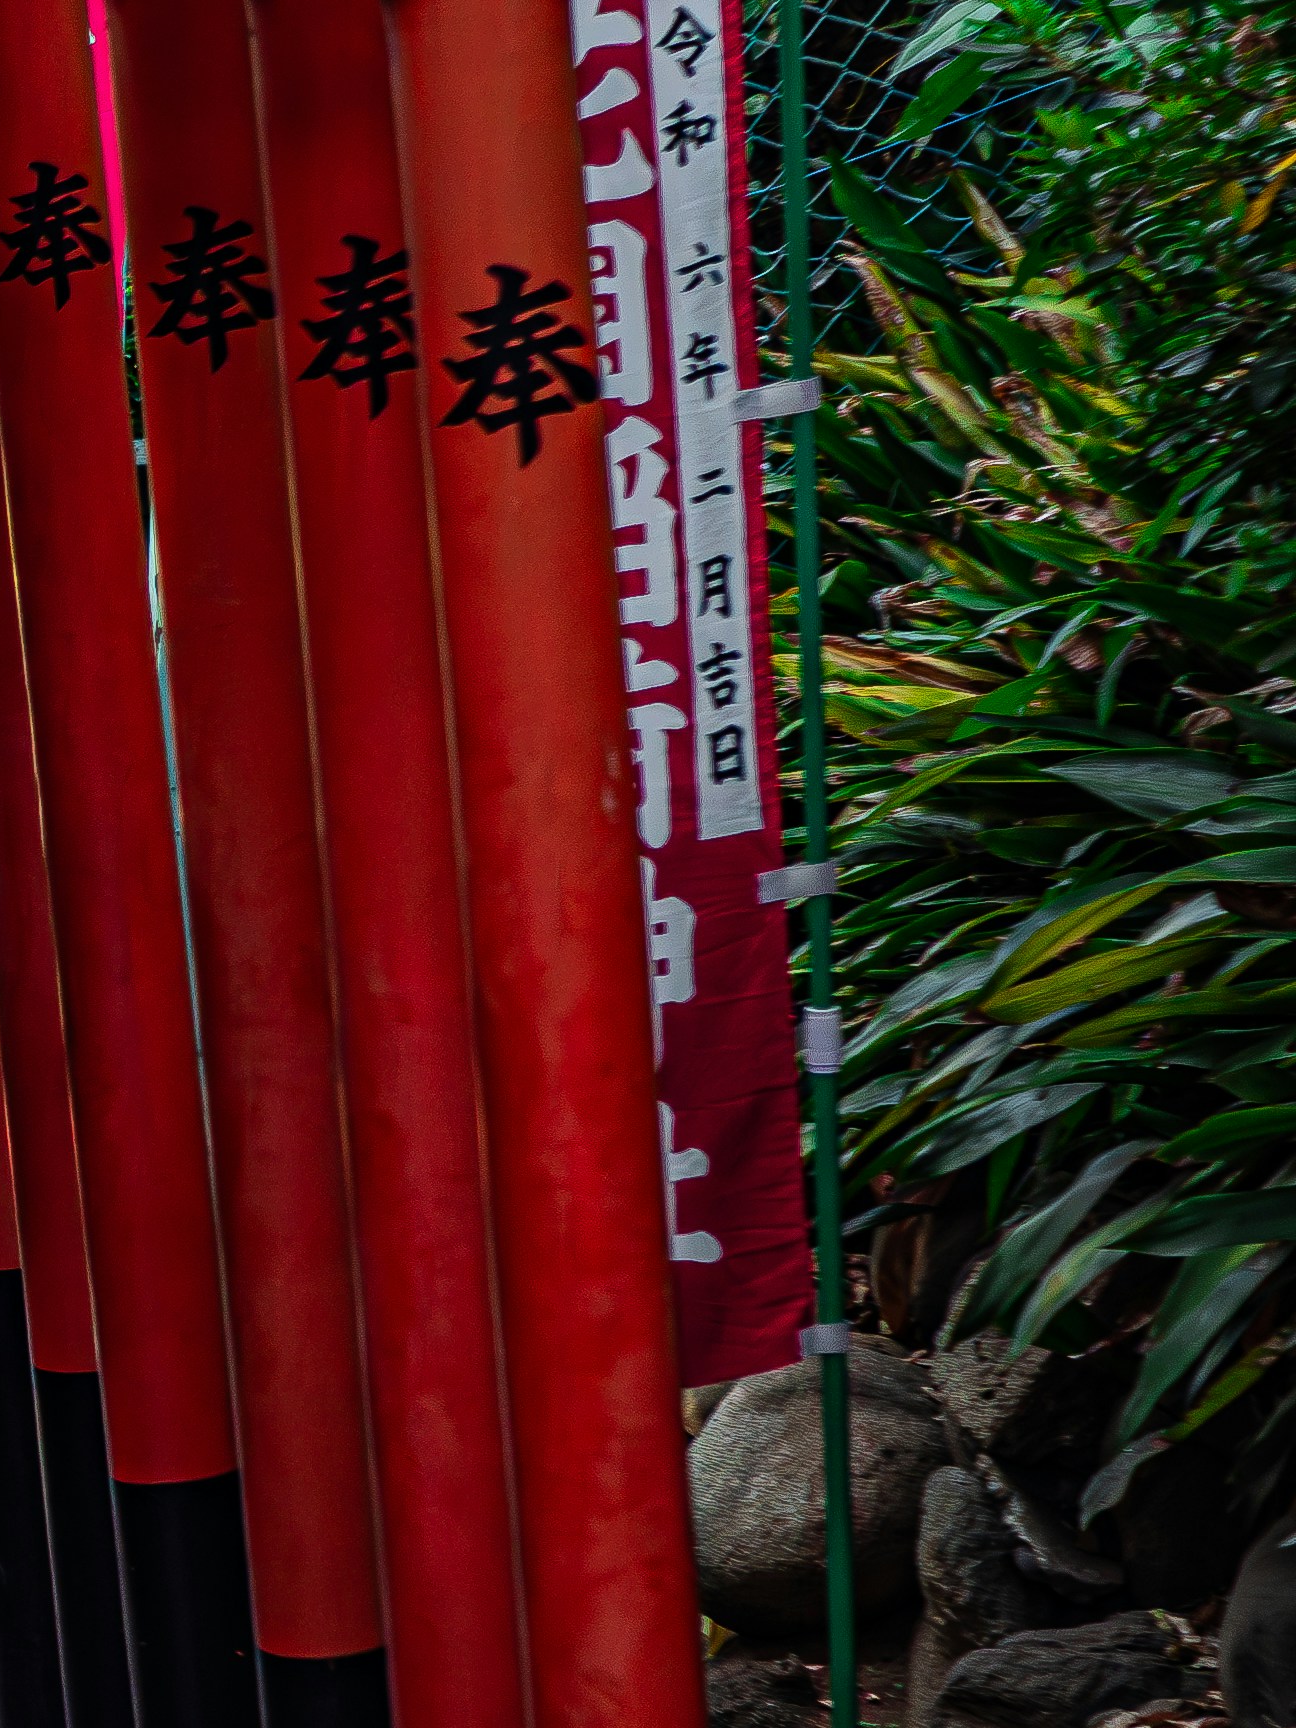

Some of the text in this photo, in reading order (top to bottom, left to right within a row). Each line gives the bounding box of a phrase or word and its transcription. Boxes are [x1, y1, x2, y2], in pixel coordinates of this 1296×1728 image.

[147, 206, 278, 374] 奉
[297, 235, 416, 420] 奉
[437, 264, 601, 469] 奉
[655, 5, 747, 785] 令和六年二月吉日
